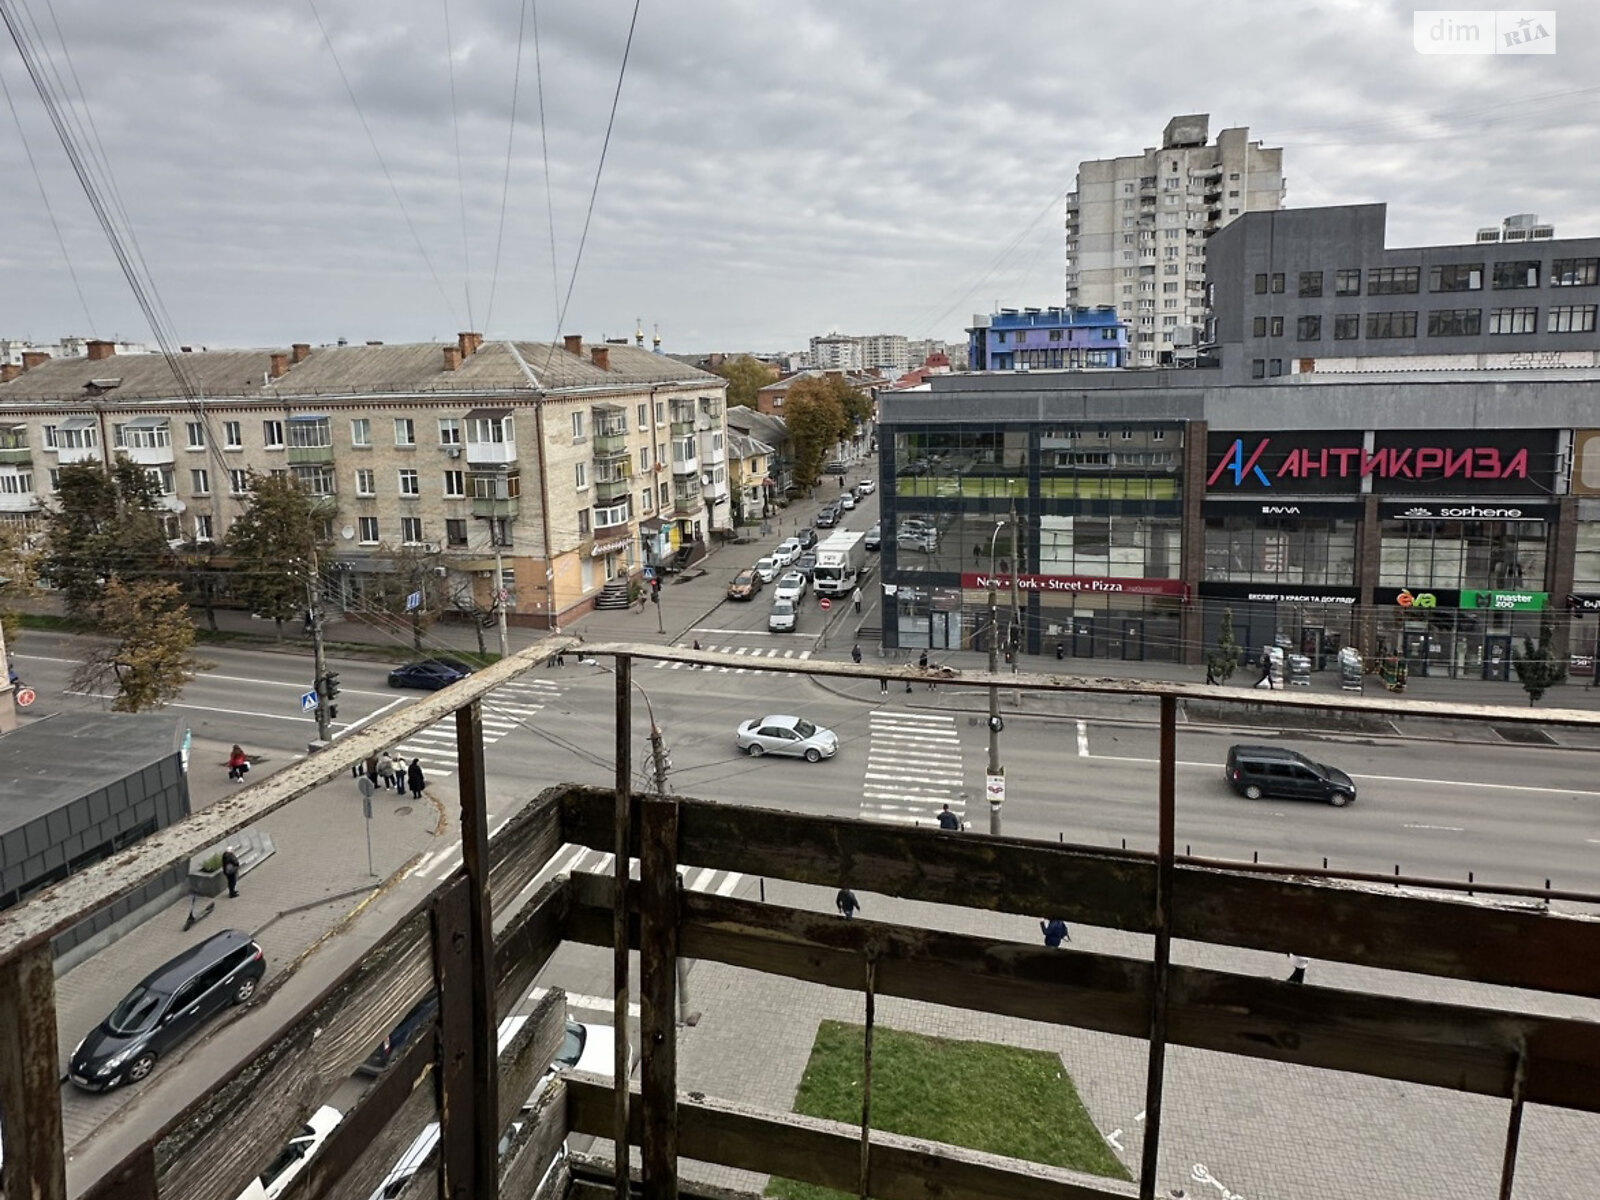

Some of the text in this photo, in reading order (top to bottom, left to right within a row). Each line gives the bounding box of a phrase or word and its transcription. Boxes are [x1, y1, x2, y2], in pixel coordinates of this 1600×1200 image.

[1277, 447, 1528, 479] АНТИКРИЗА
[1048, 579, 1082, 590] Street
[1092, 581, 1123, 591] Pizza
[1321, 596, 1356, 604] ДОГЛЯДУ
[1495, 594, 1533, 603] master
